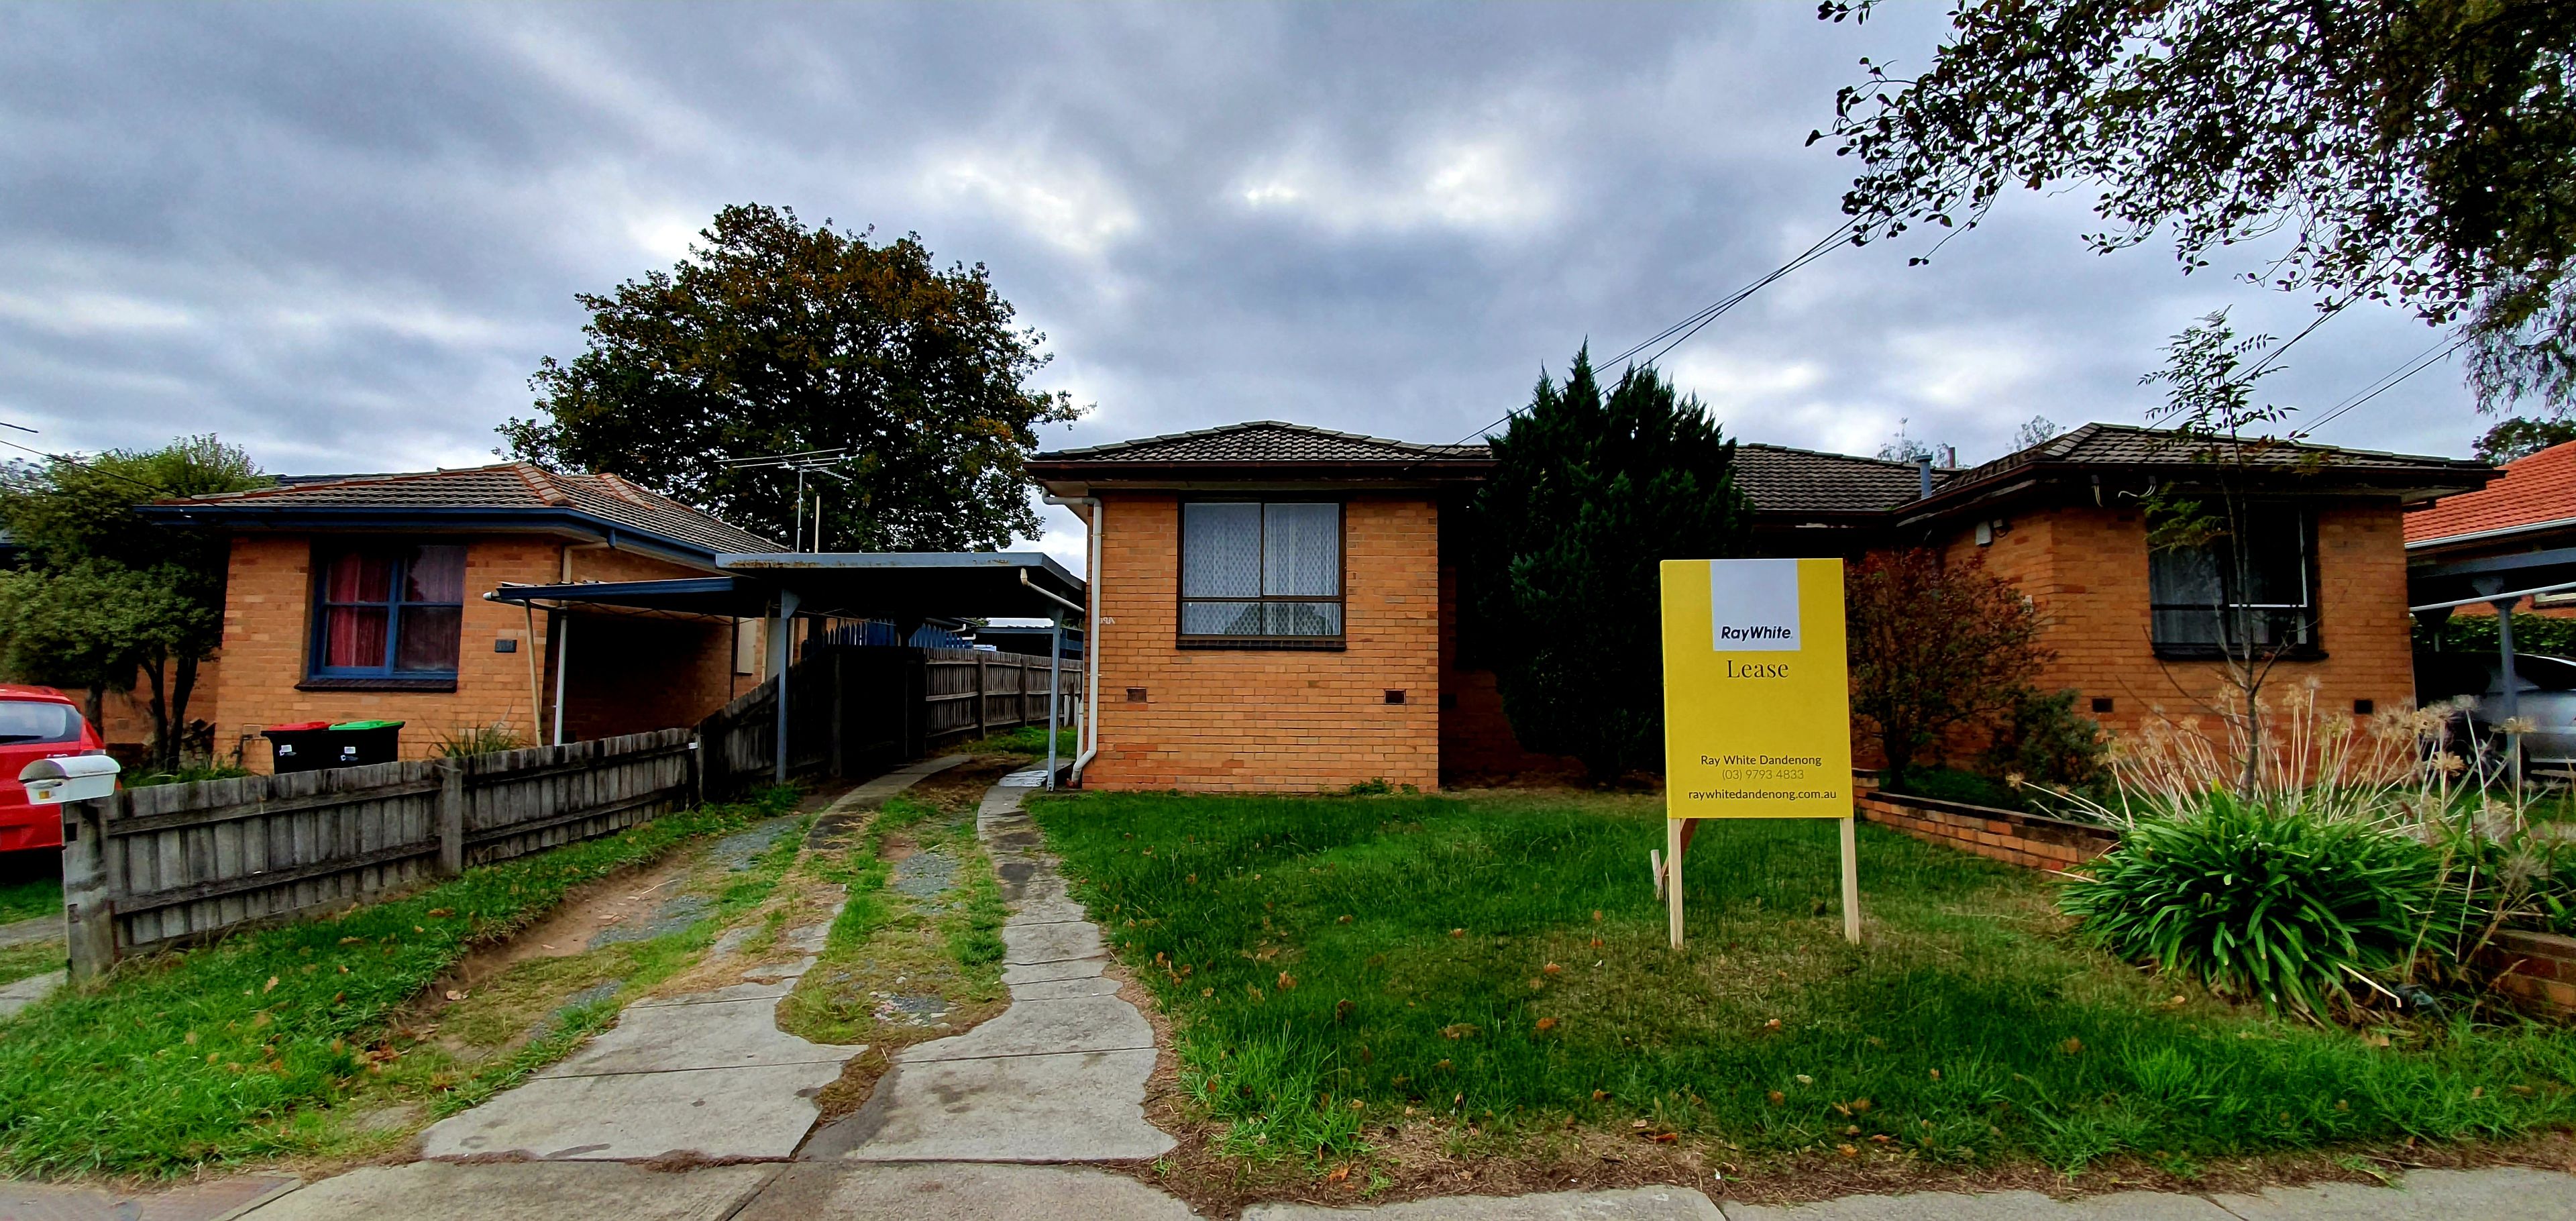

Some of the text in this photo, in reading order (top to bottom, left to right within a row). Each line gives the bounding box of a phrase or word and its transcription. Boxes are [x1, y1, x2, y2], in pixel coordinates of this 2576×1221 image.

[1721, 625, 1792, 641] RayWhite
[1727, 660, 1788, 678] Lease
[1701, 755, 1822, 767] Ray White Dandenong
[1722, 769, 1805, 780] (03) 9793 4833
[1688, 789, 1837, 800] raywhitedandenong.com.au
